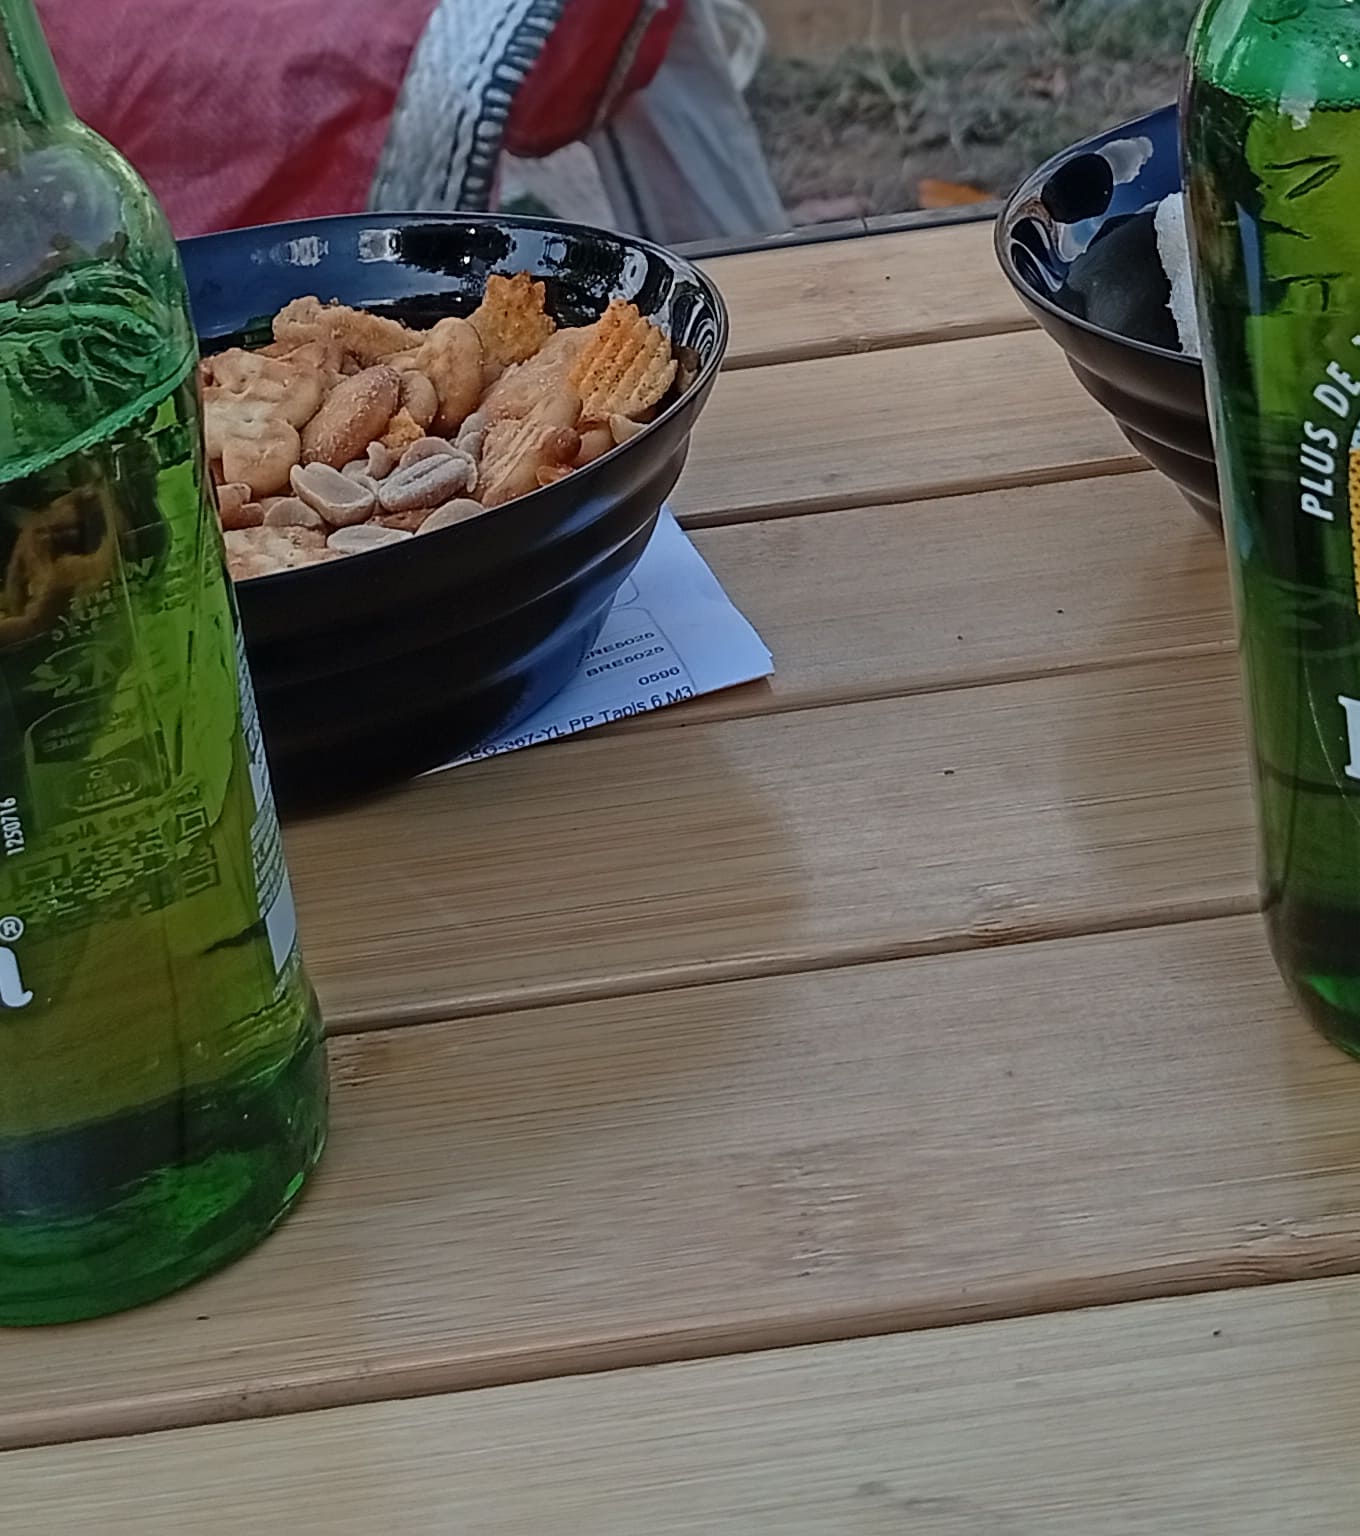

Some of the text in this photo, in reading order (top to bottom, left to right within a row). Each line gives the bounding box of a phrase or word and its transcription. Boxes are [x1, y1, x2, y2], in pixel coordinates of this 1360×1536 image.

[1301, 421, 1339, 522] PLUS
[569, 716, 594, 732] PP
[650, 694, 663, 709] 6
[665, 685, 693, 704] M3
